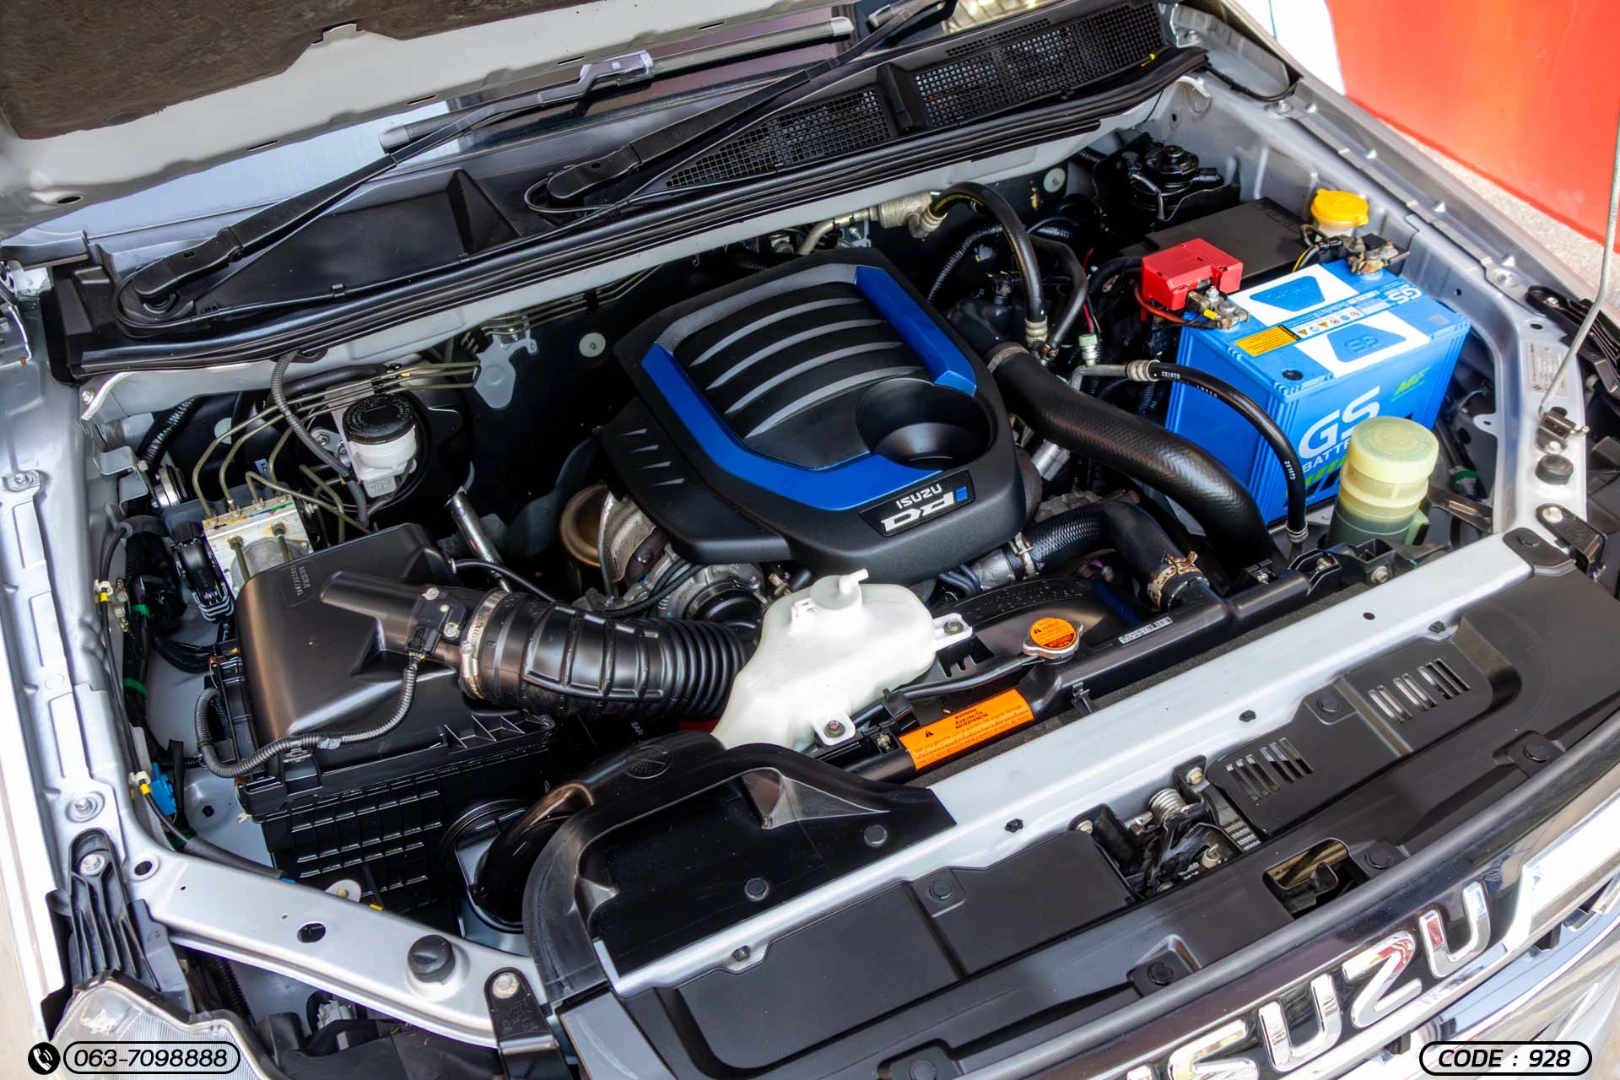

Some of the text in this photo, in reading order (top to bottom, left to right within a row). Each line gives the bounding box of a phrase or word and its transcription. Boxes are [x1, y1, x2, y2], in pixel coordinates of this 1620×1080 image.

[1298, 385, 1381, 459] GS
[1301, 437, 1351, 474] BATT
[896, 483, 943, 509] ISUZU
[1126, 879, 1492, 1080] SUZU
